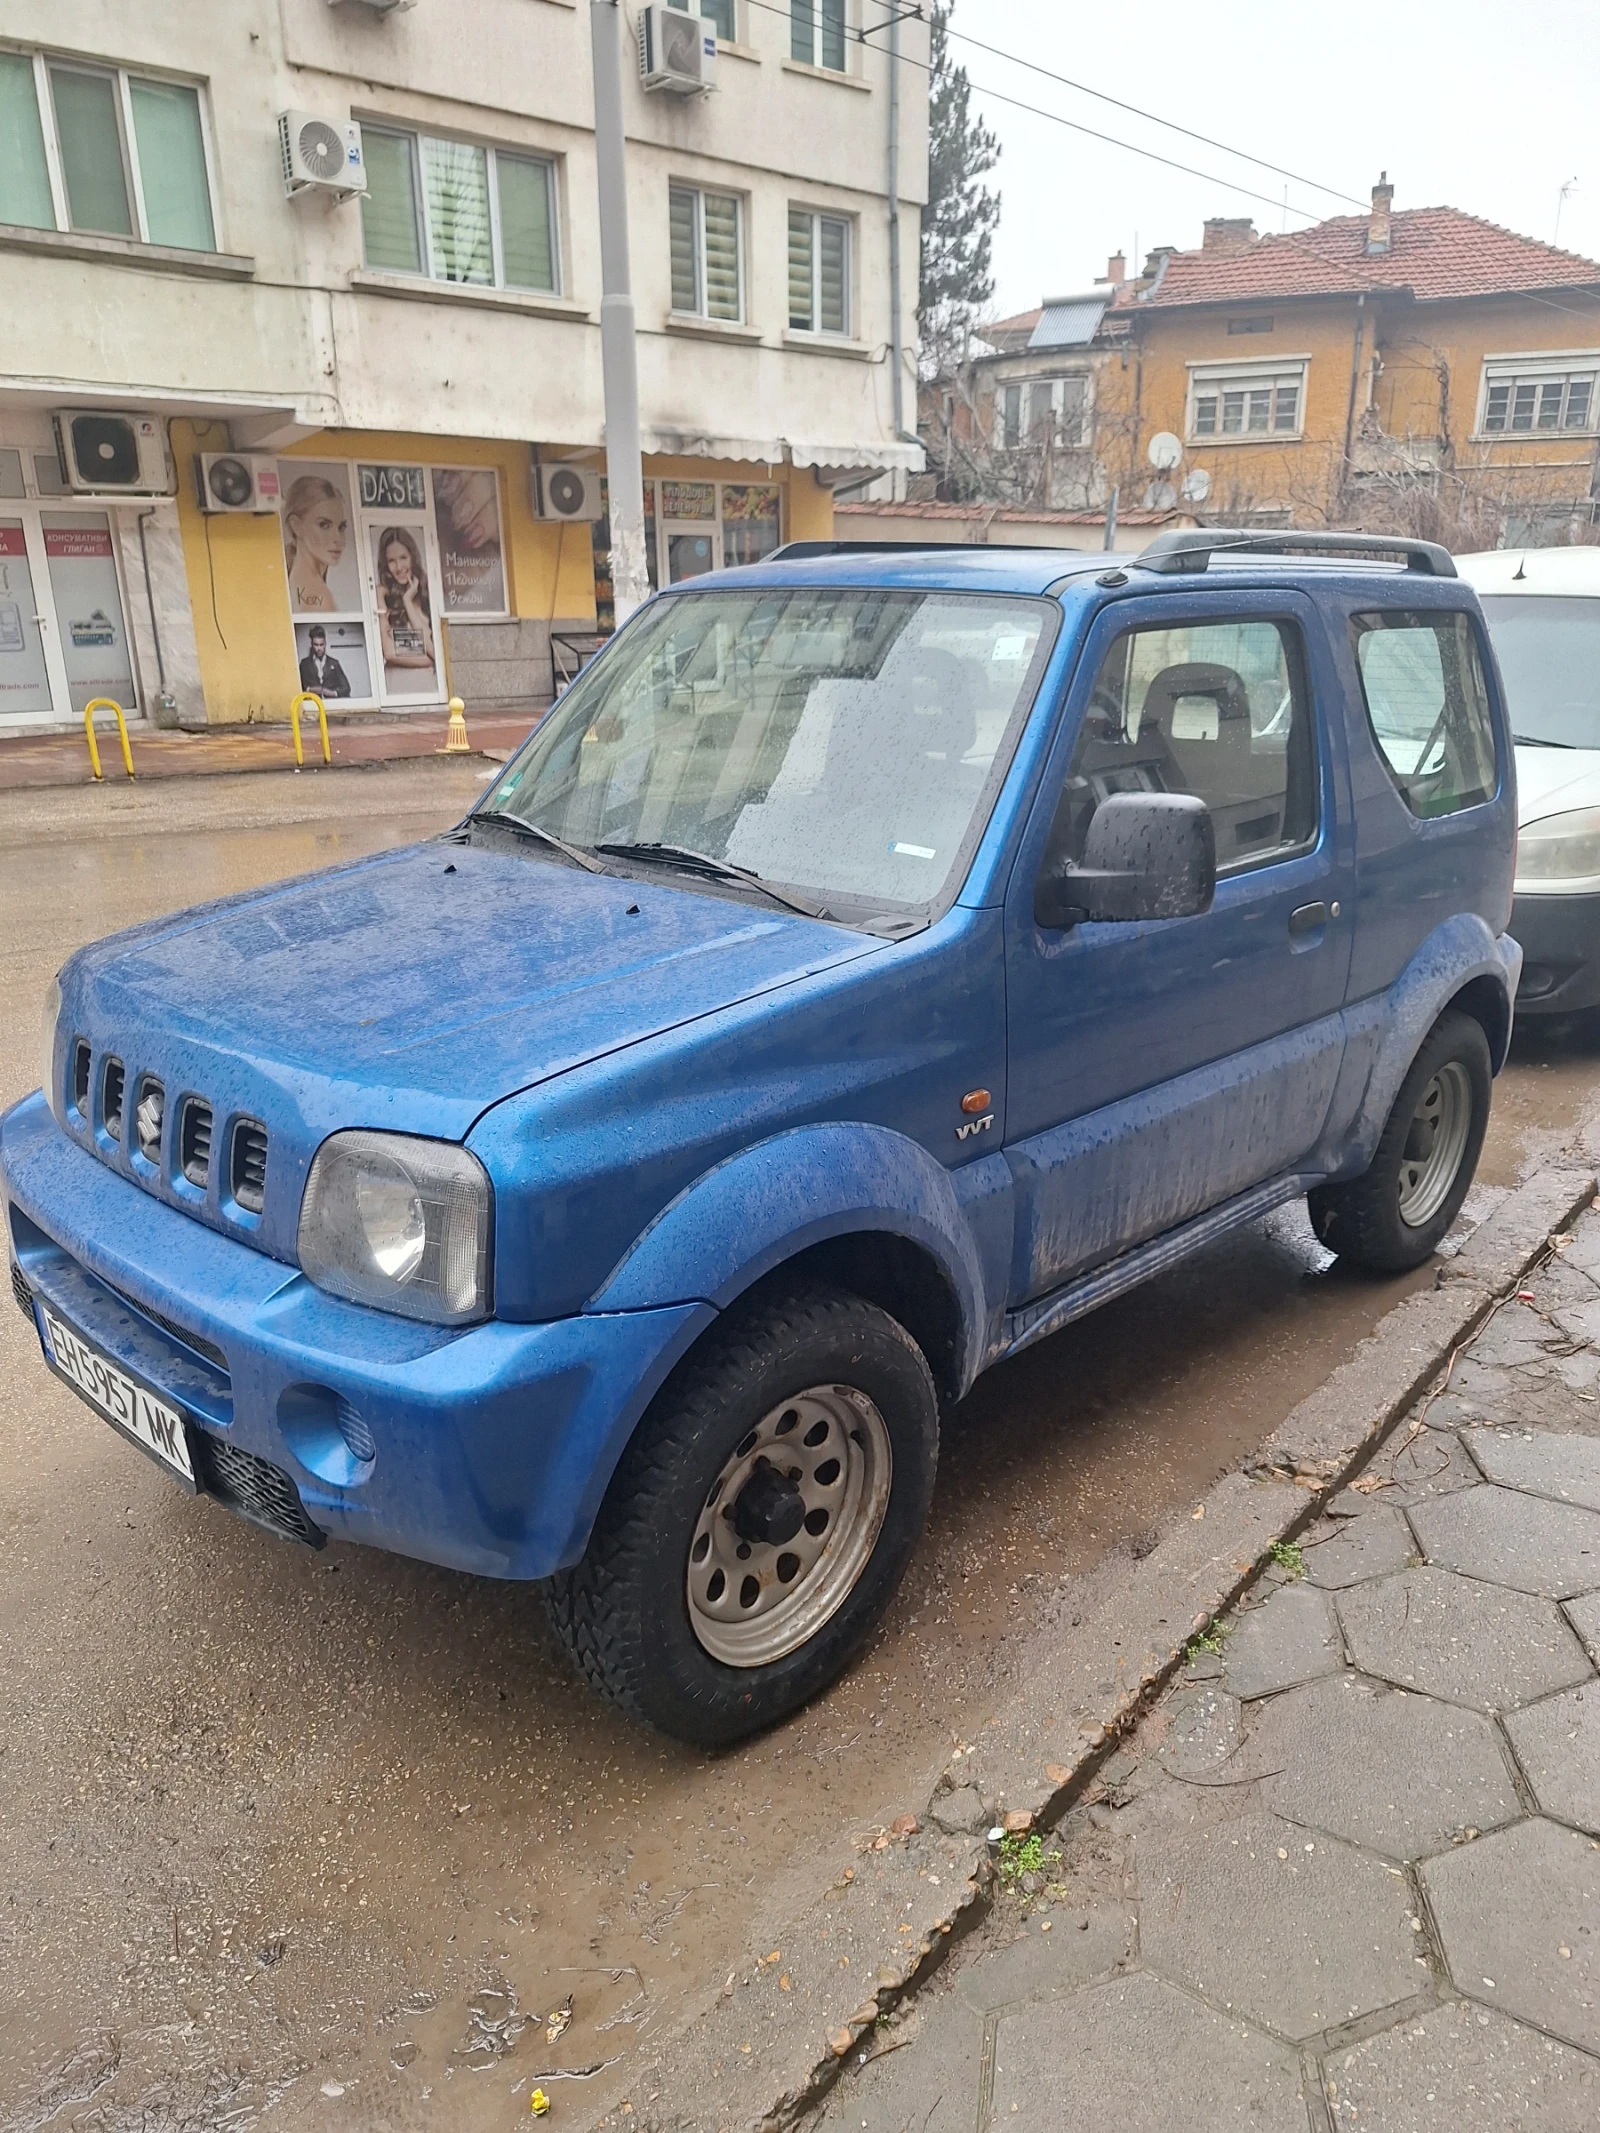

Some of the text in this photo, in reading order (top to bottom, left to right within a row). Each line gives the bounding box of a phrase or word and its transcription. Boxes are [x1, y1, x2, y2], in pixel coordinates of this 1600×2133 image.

[362, 471, 424, 504] DASH
[47, 533, 107, 542] КОНСУМАТИВИ
[63, 544, 95, 553] ГЛИГАН
[446, 551, 498, 570] Маникюр
[955, 1114, 995, 1141] VVT
